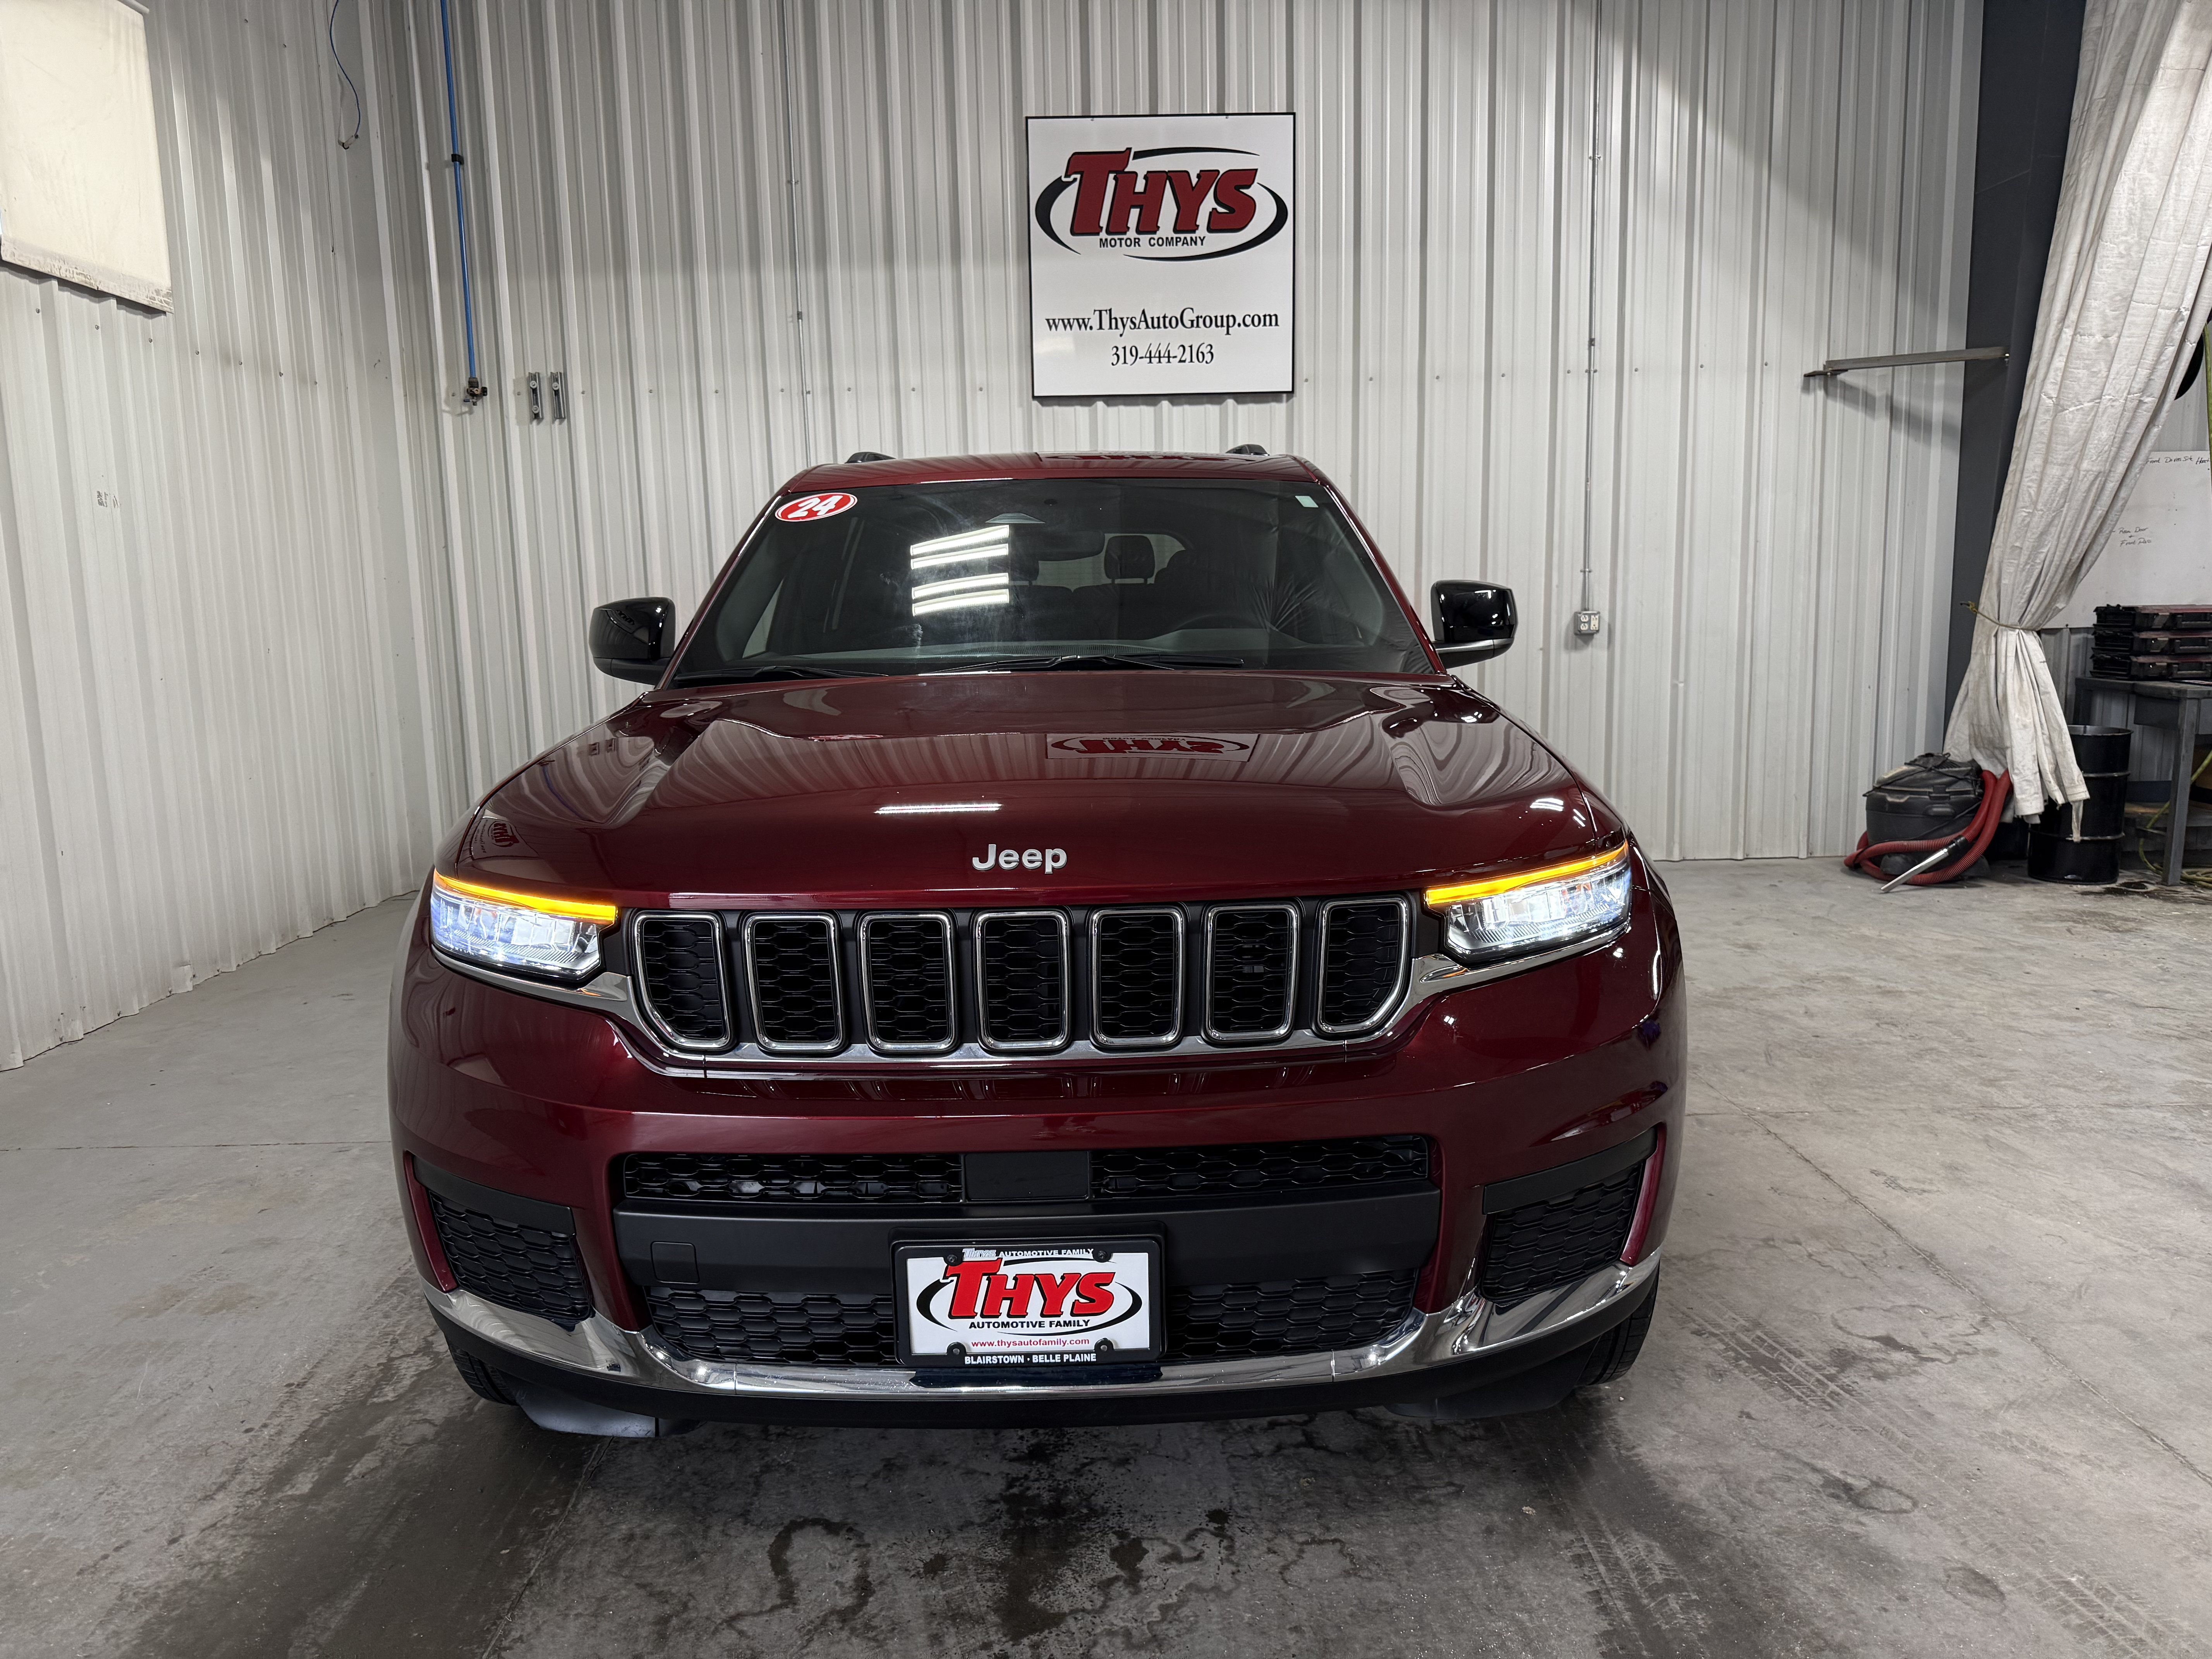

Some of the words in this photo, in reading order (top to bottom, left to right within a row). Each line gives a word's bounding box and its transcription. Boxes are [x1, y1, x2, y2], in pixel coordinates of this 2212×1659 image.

[1063, 148, 1258, 237] THYS
[1099, 237, 1141, 248] MOTOR
[1149, 236, 1206, 247] COMPANY
[1045, 307, 1279, 337] www.ThysAutoGroup.com
[1111, 343, 1214, 366] 319-444-2163
[787, 495, 843, 519] 24
[972, 844, 1067, 874] Jeep
[943, 1259, 1115, 1319] THYS
[969, 1321, 1045, 1329] AUTOMOTIVE
[1049, 1319, 1090, 1328] FAMILY
[971, 1338, 1089, 1348] www.thysautofamily.com
[965, 1355, 1024, 1364] BLAIRSTOWN
[1032, 1354, 1061, 1363] BELLE
[1063, 1353, 1096, 1362] PLAINE
